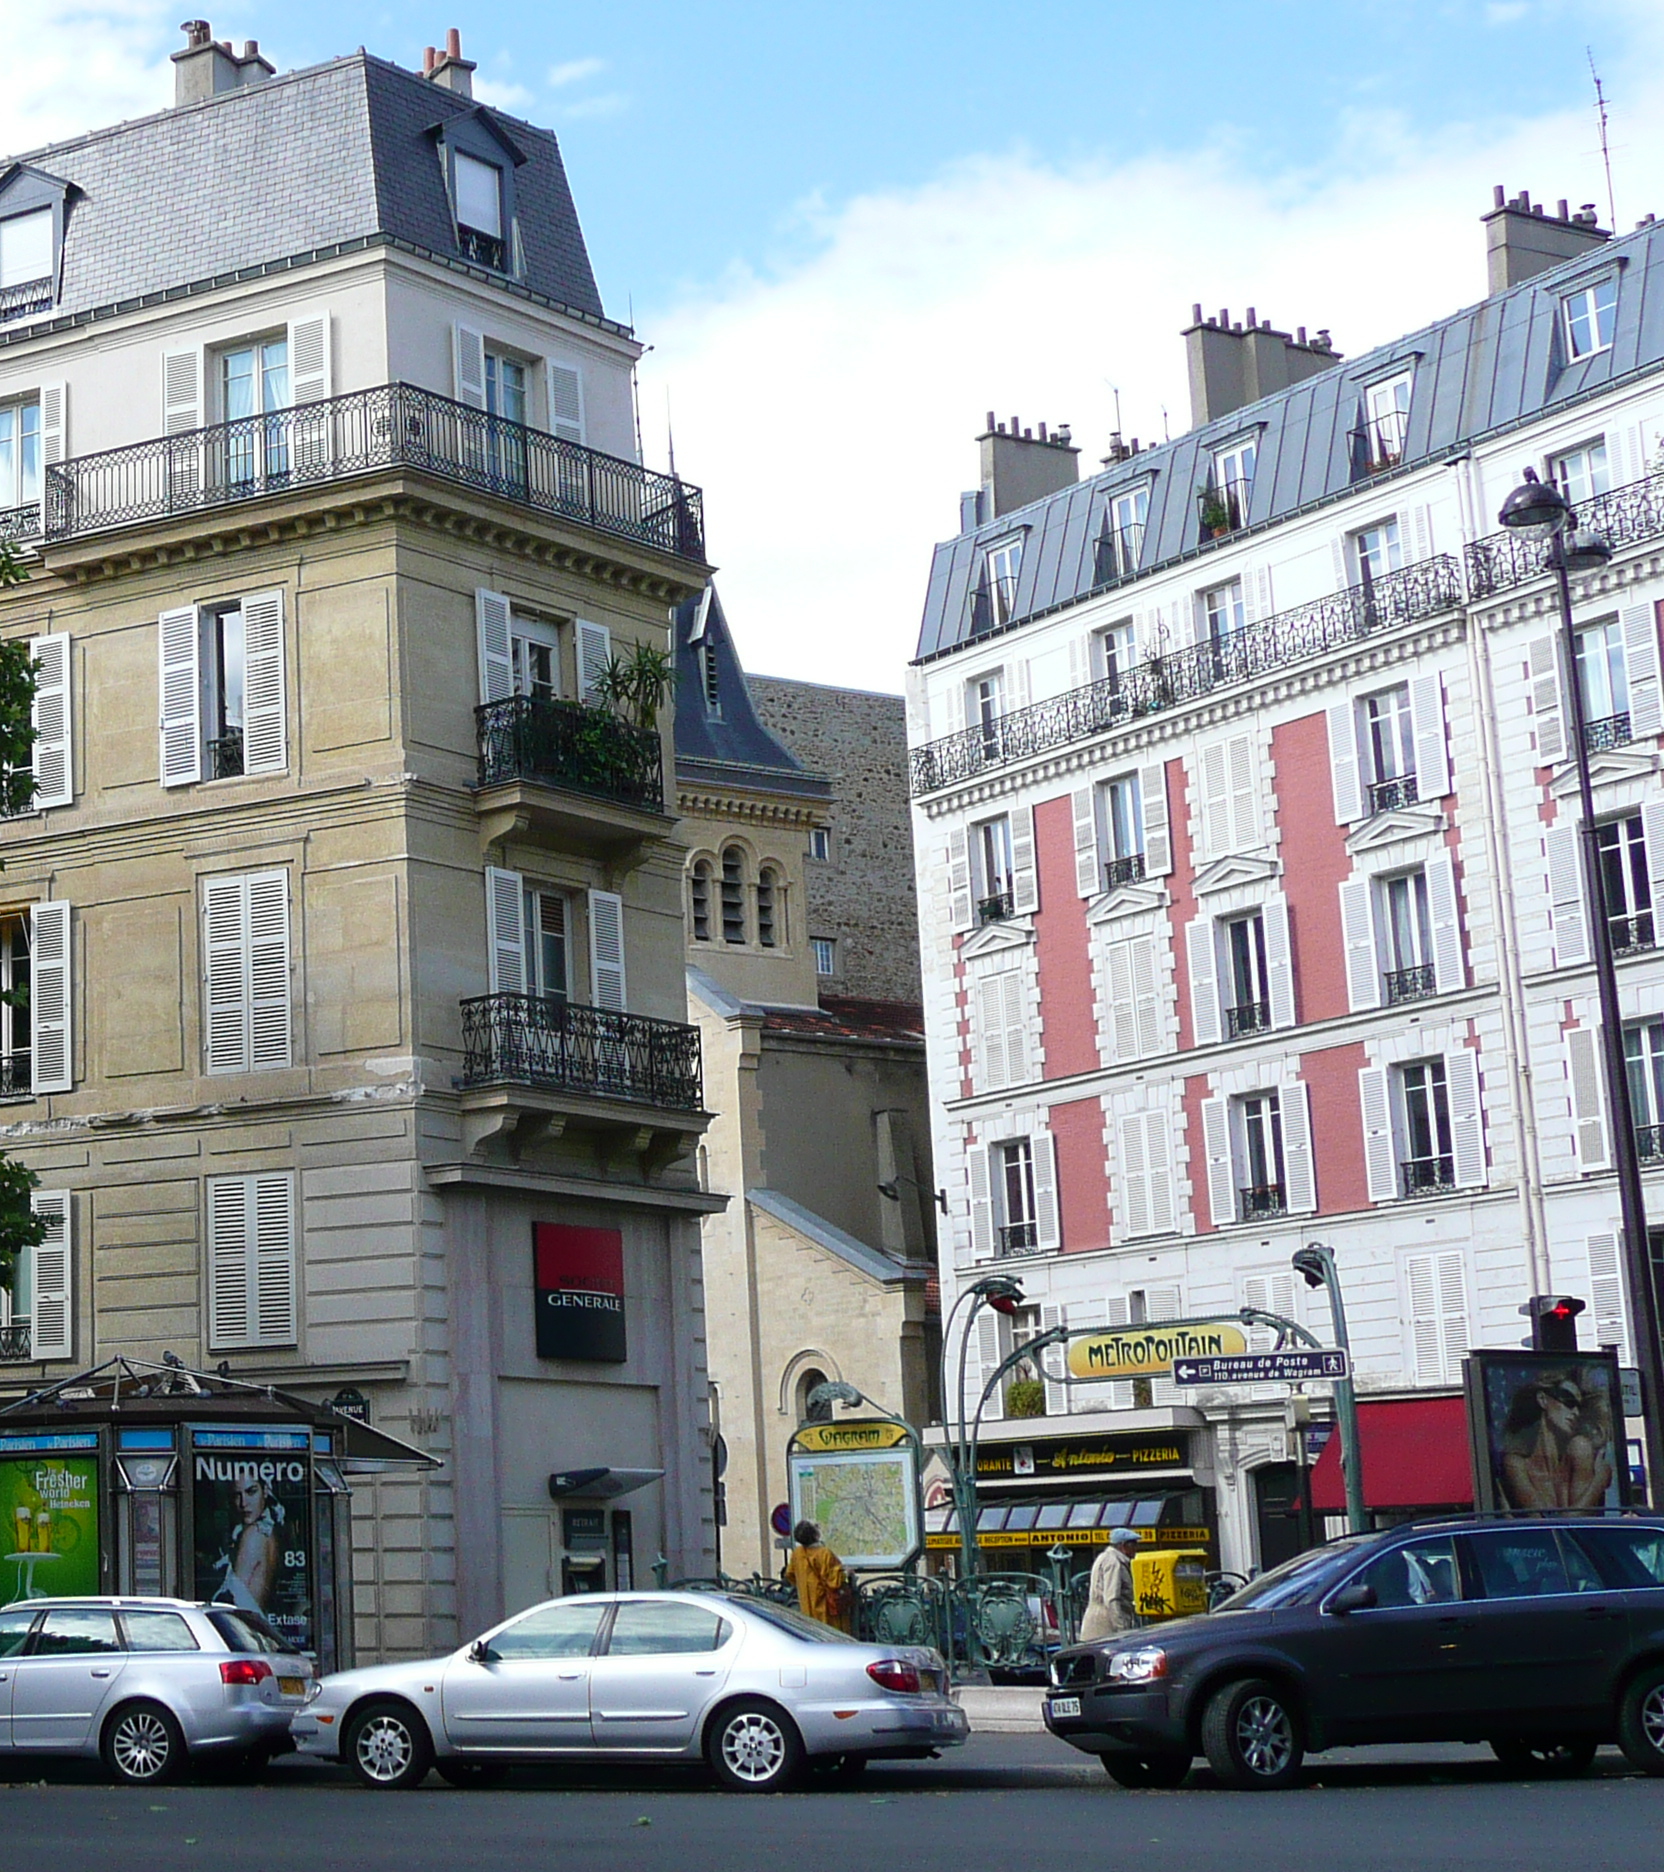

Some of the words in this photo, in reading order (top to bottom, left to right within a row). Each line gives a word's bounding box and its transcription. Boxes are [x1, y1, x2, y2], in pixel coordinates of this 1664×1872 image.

[547, 1294, 621, 1312] GENERALE
[1213, 1360, 1253, 1370] Bureau
[1258, 1357, 1271, 1368] de
[1276, 1356, 1308, 1367] Poste
[1232, 1371, 1265, 1379] avenue
[1268, 1369, 1279, 1378] de
[1283, 1367, 1321, 1378] Wagram
[1, 1438, 36, 1450] Parisien
[54, 1436, 90, 1448] Parisien
[208, 1433, 245, 1446] Parisien
[819, 1428, 880, 1446] WAGRAM
[977, 1457, 1011, 1472] ORANTE
[1052, 1443, 1115, 1469] Antonio
[1132, 1447, 1180, 1462] PIZZERIA
[36, 1470, 87, 1490] Fresher
[39, 1488, 70, 1499] world
[50, 1499, 91, 1509] Heineken
[1031, 1532, 1089, 1543] ANTONIO
[1094, 1532, 1105, 1541] TEL
[1160, 1529, 1206, 1539] PIZZERIA
[284, 1551, 306, 1567] 83
